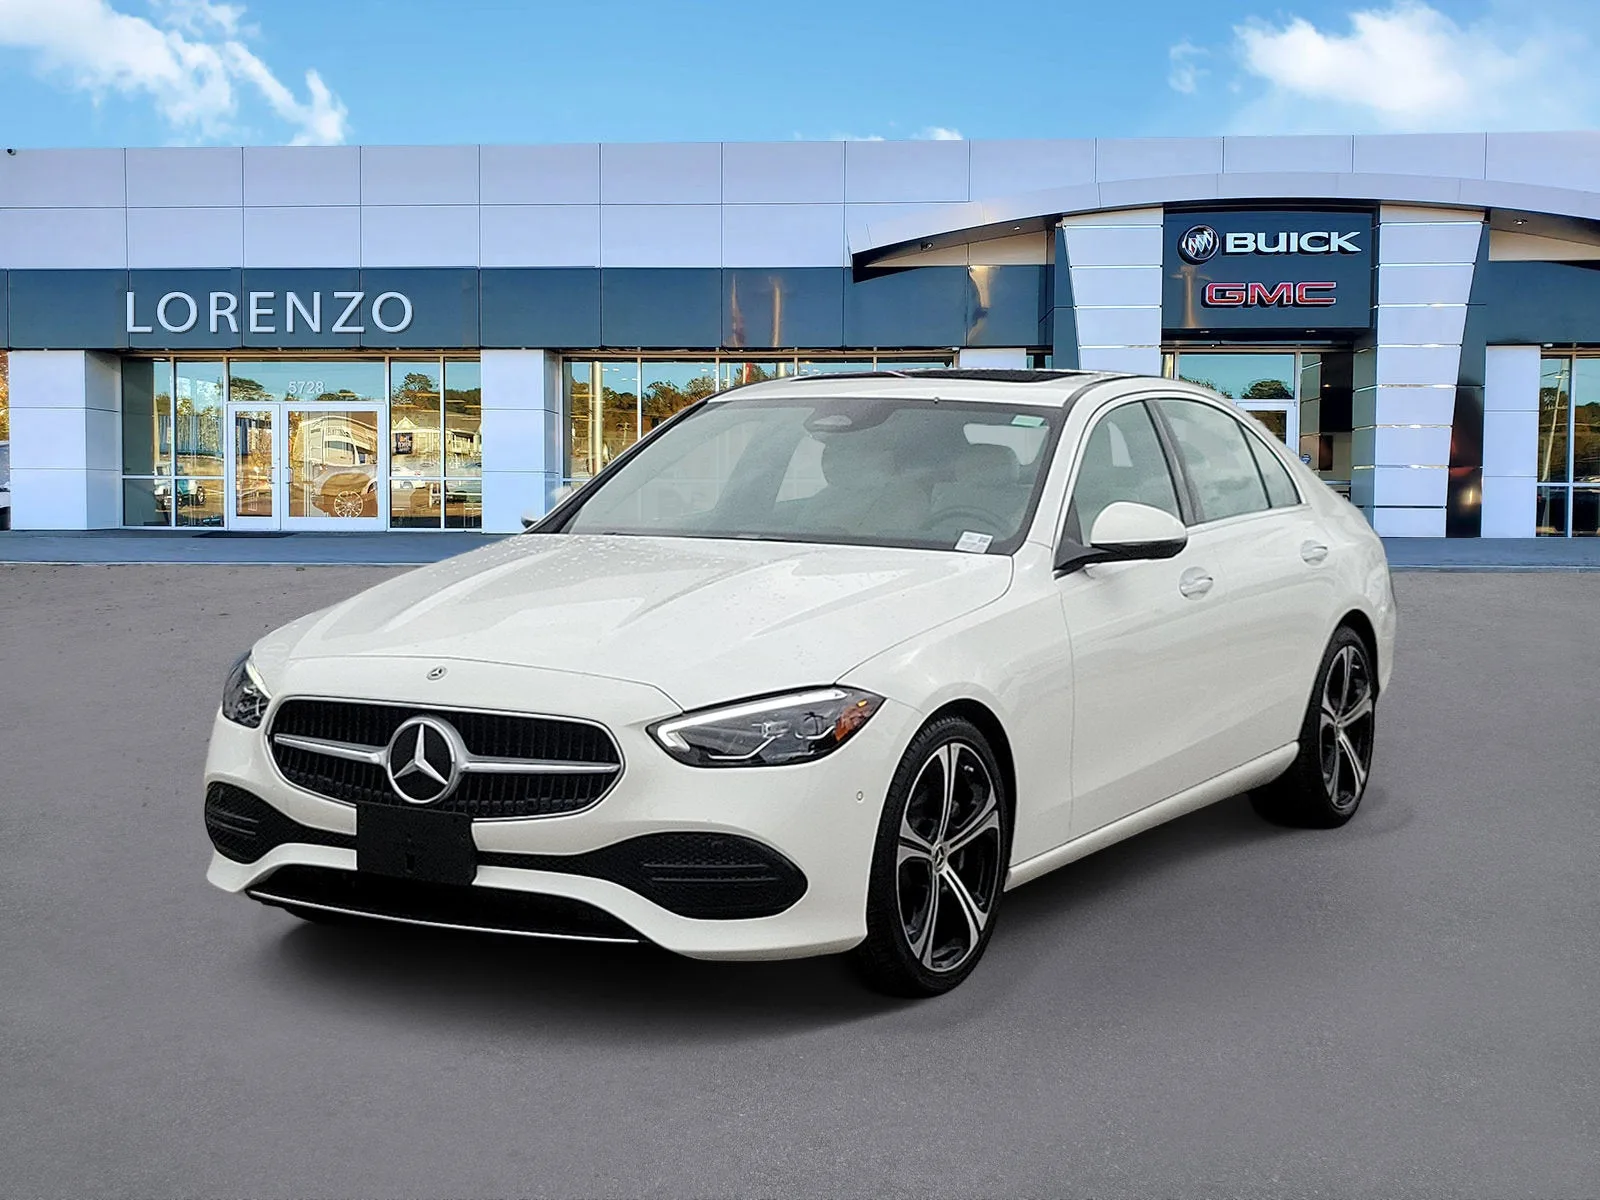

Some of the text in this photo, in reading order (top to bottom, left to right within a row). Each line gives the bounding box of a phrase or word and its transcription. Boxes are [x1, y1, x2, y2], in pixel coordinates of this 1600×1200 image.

[1225, 231, 1362, 253] BUICK
[1204, 281, 1337, 305] GMC
[126, 291, 414, 333] LORENZO
[288, 380, 325, 394] 5728
